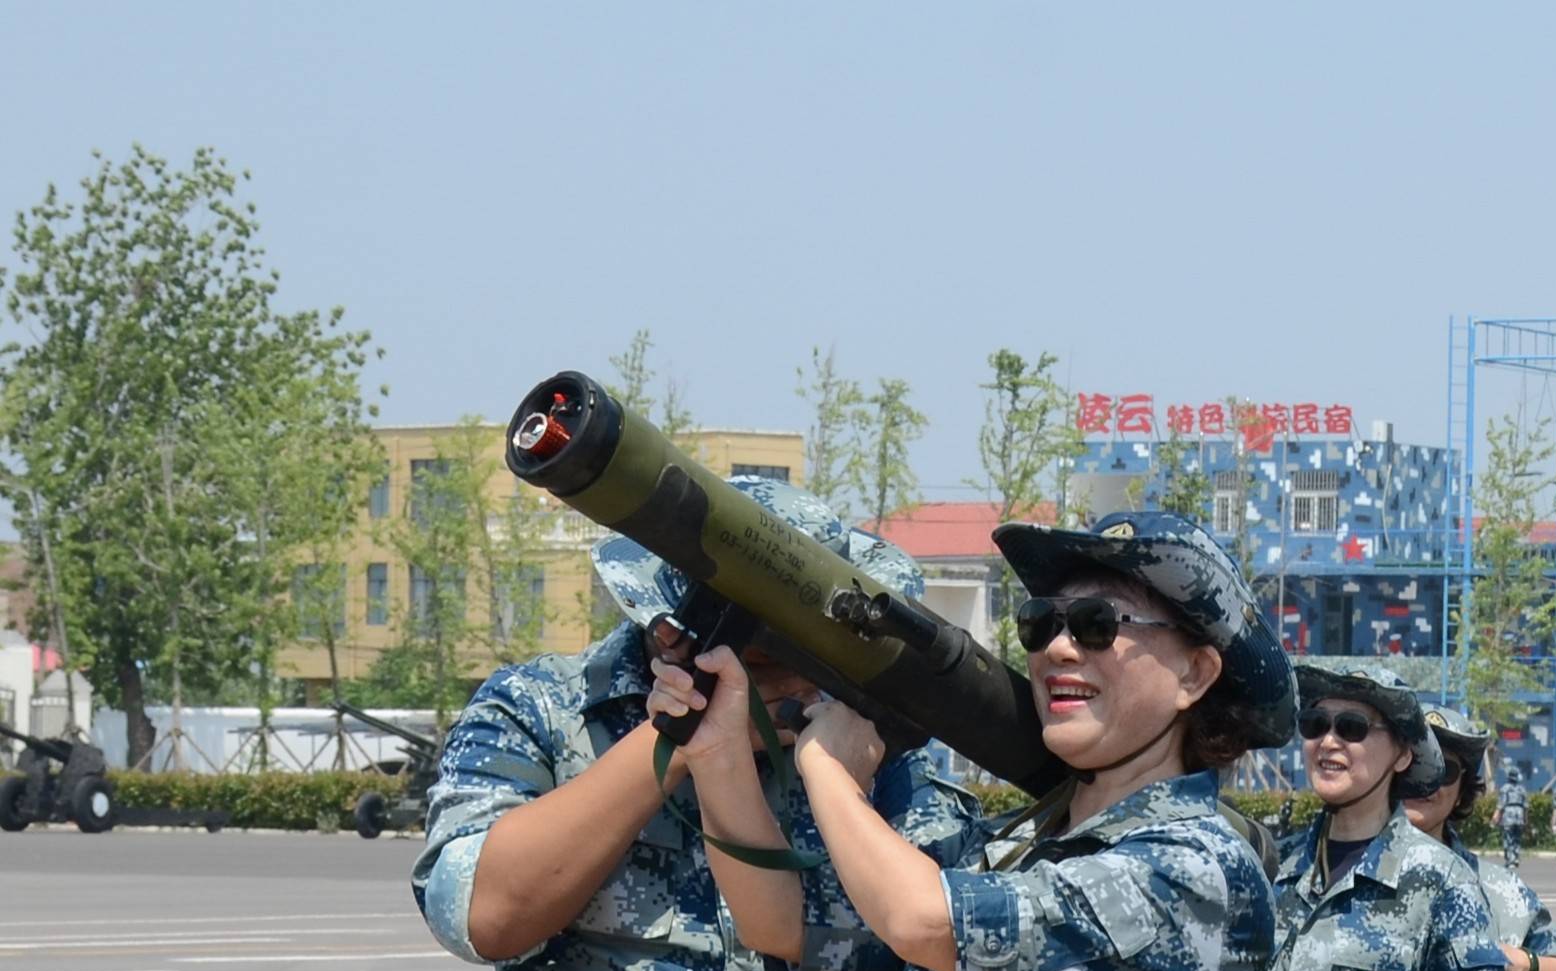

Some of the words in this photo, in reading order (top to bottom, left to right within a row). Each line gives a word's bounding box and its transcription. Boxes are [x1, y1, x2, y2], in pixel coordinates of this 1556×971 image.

[1076, 392, 1153, 434] 凌云
[1167, 402, 1352, 434] 特色旅民宿
